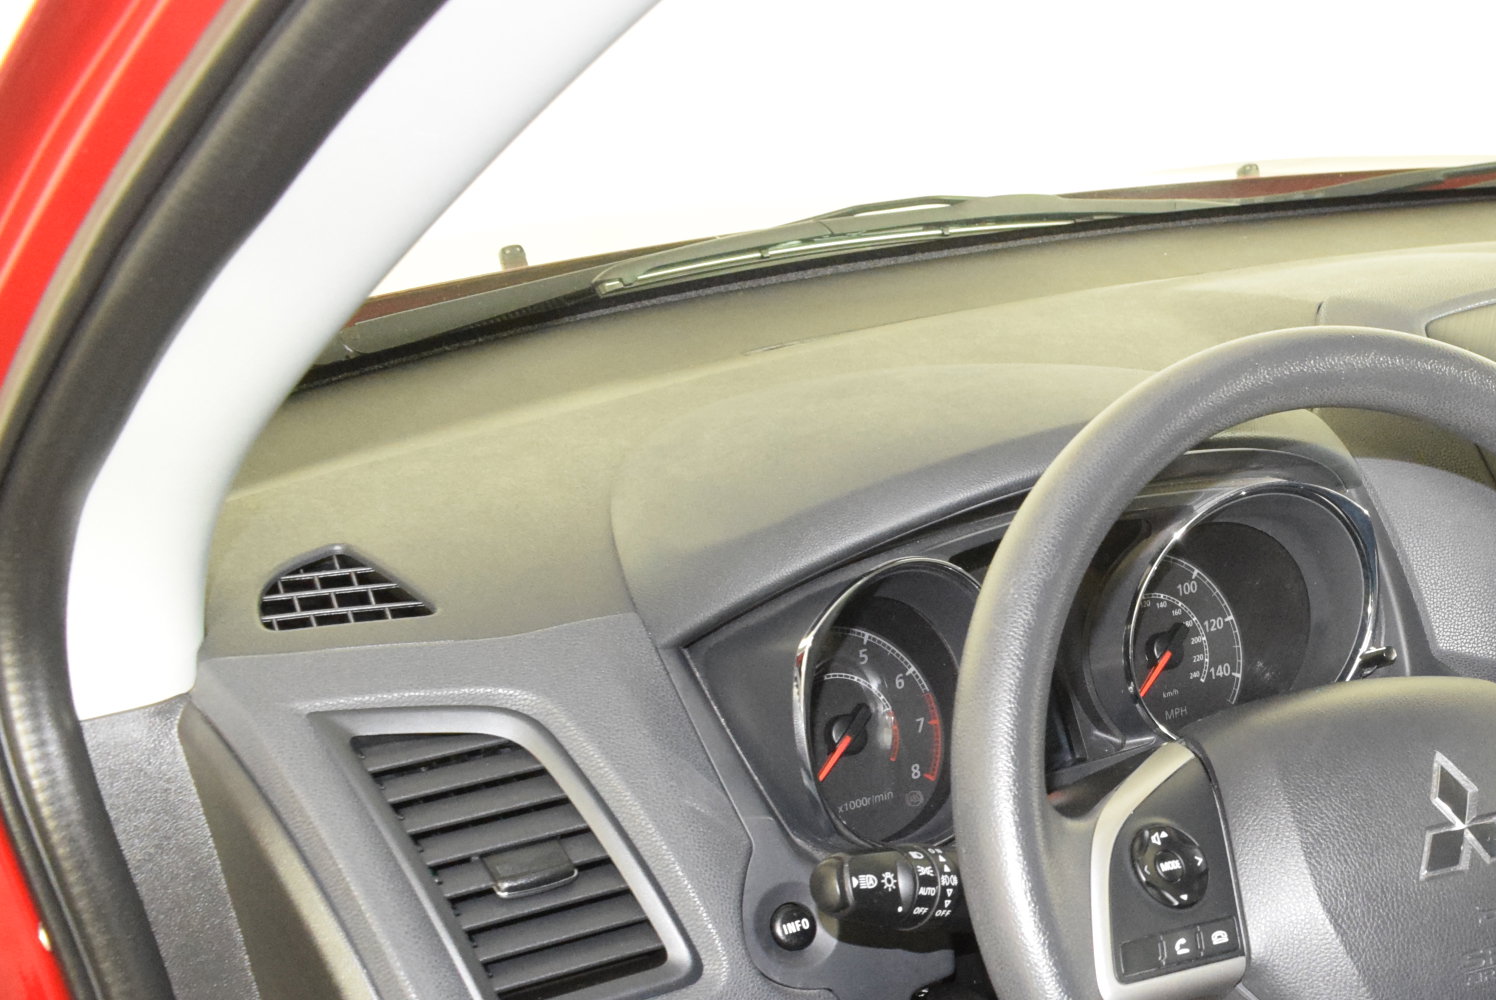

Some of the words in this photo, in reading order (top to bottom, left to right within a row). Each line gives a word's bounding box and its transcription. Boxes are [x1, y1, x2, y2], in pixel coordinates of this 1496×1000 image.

[1176, 580, 1198, 597] 100
[1156, 600, 1167, 609] 140
[1171, 608, 1182, 617] 160
[1203, 617, 1224, 633] 120
[1191, 636, 1201, 645] 200
[859, 649, 869, 665] 5
[1192, 654, 1204, 663] 220
[1189, 671, 1200, 680] 240
[1209, 663, 1231, 680] 140
[895, 674, 905, 690] 6
[1162, 688, 1179, 698] km/h
[1164, 706, 1188, 721] MPH
[916, 717, 925, 734] 7
[911, 763, 921, 780] 8
[1159, 859, 1182, 872] MODE
[918, 886, 937, 896] AUTO
[913, 907, 928, 915] OFF
[935, 909, 951, 917] OFF
[782, 918, 810, 935] INFO
